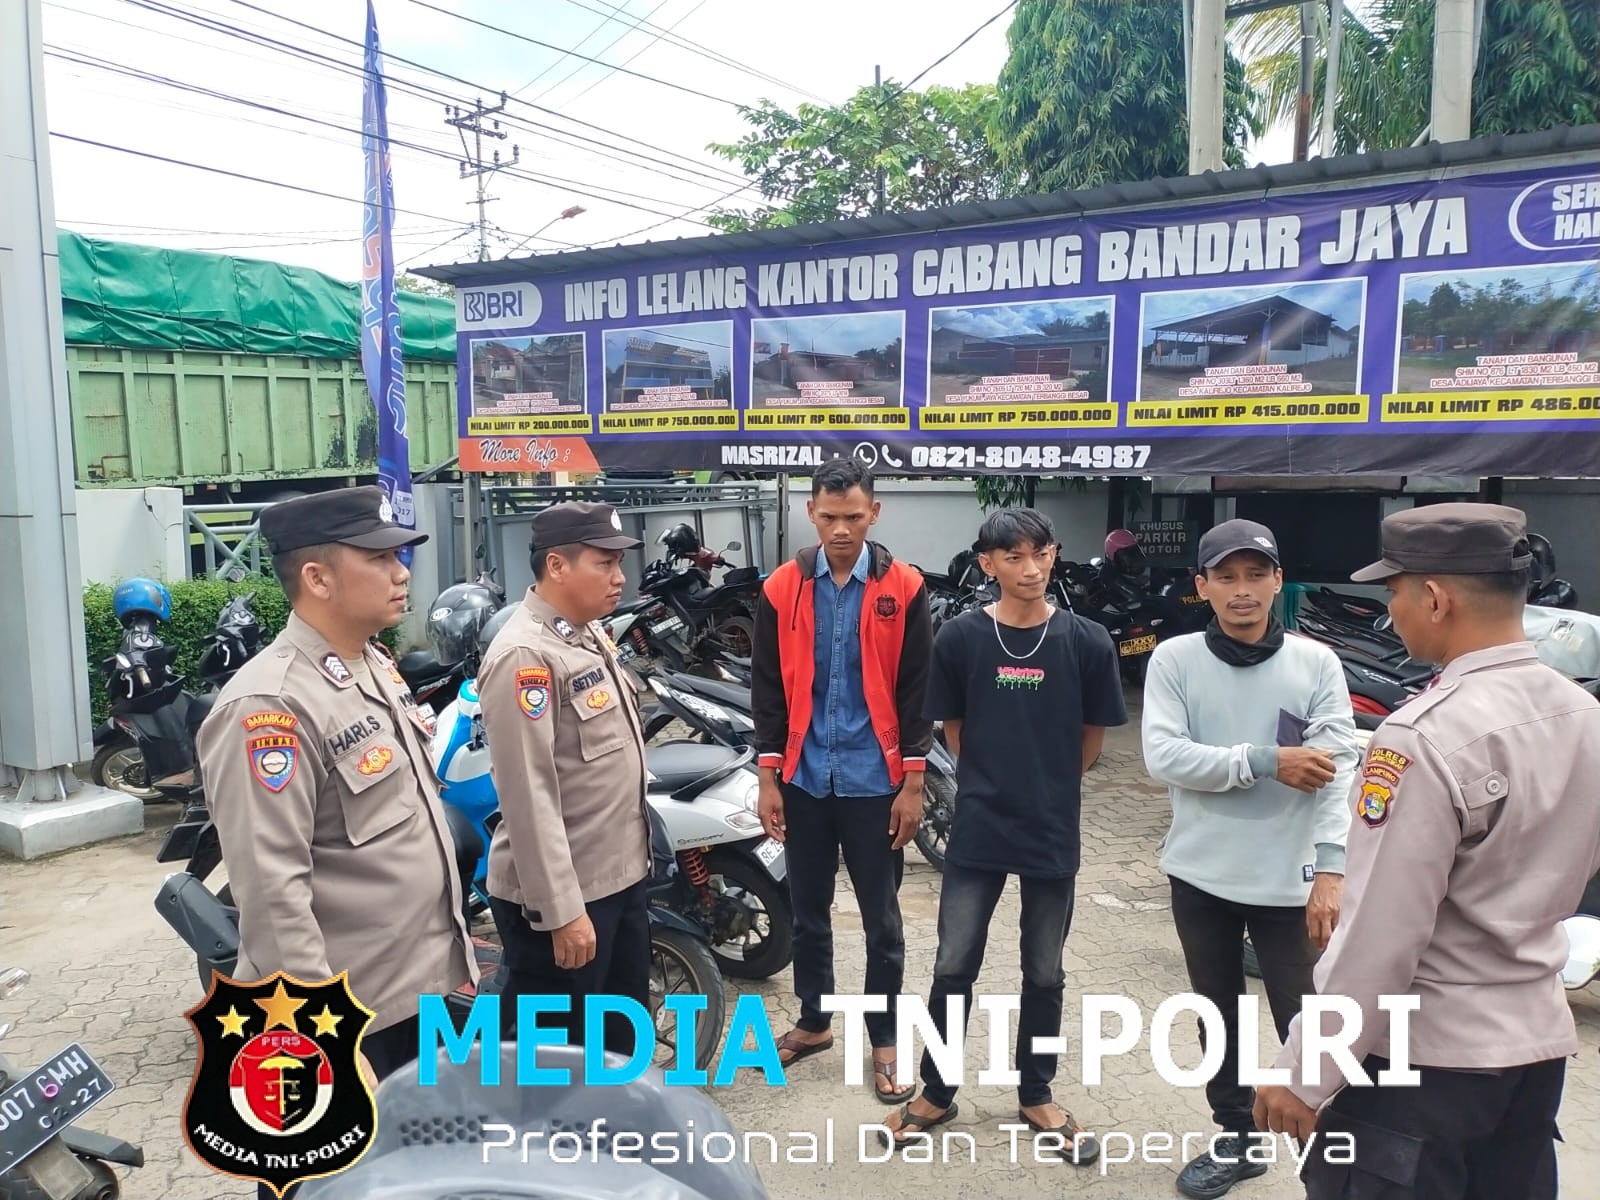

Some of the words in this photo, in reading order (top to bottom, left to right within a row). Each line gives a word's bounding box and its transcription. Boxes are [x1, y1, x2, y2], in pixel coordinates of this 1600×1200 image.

[564, 278, 628, 323] INFO
[637, 266, 747, 317] LELANG
[757, 253, 899, 307] KANTOR
[912, 234, 1083, 297] CABANG
[1097, 214, 1302, 283] BANDAR
[1320, 196, 1468, 265] JAYA
[486, 290, 523, 318] BRI
[1134, 407, 1171, 420] NILAI
[1177, 406, 1218, 419] LIMIT
[1224, 405, 1247, 418] RP
[1251, 402, 1361, 417] 415.000.000
[1387, 401, 1434, 415] NILAI
[1440, 399, 1490, 414] LIMIT
[1497, 398, 1523, 412] RP
[602, 418, 627, 428] NILAI
[629, 417, 654, 428] LIMIT
[657, 416, 669, 427] RP
[747, 415, 774, 425] NILAI
[777, 414, 806, 425] LIMIT
[810, 414, 825, 424] RP
[828, 413, 906, 424] 600.000.000
[924, 412, 956, 424] NILAI
[959, 411, 994, 424] LIMIT
[998, 411, 1016, 423] RP
[1020, 408, 1112, 422] 750.000.000
[470, 421, 493, 431] NILAI
[518, 421, 530, 430] RP
[479, 438, 521, 463] More
[526, 438, 558, 470] Info
[721, 445, 825, 466] MASRIZAL
[911, 445, 1152, 469] 0821-8048-4987
[1140, 521, 1184, 531] KHUSUS
[1135, 532, 1187, 544] PARKIR
[246, 713, 293, 727] BAHARKAM
[1371, 749, 1407, 765] POLRES
